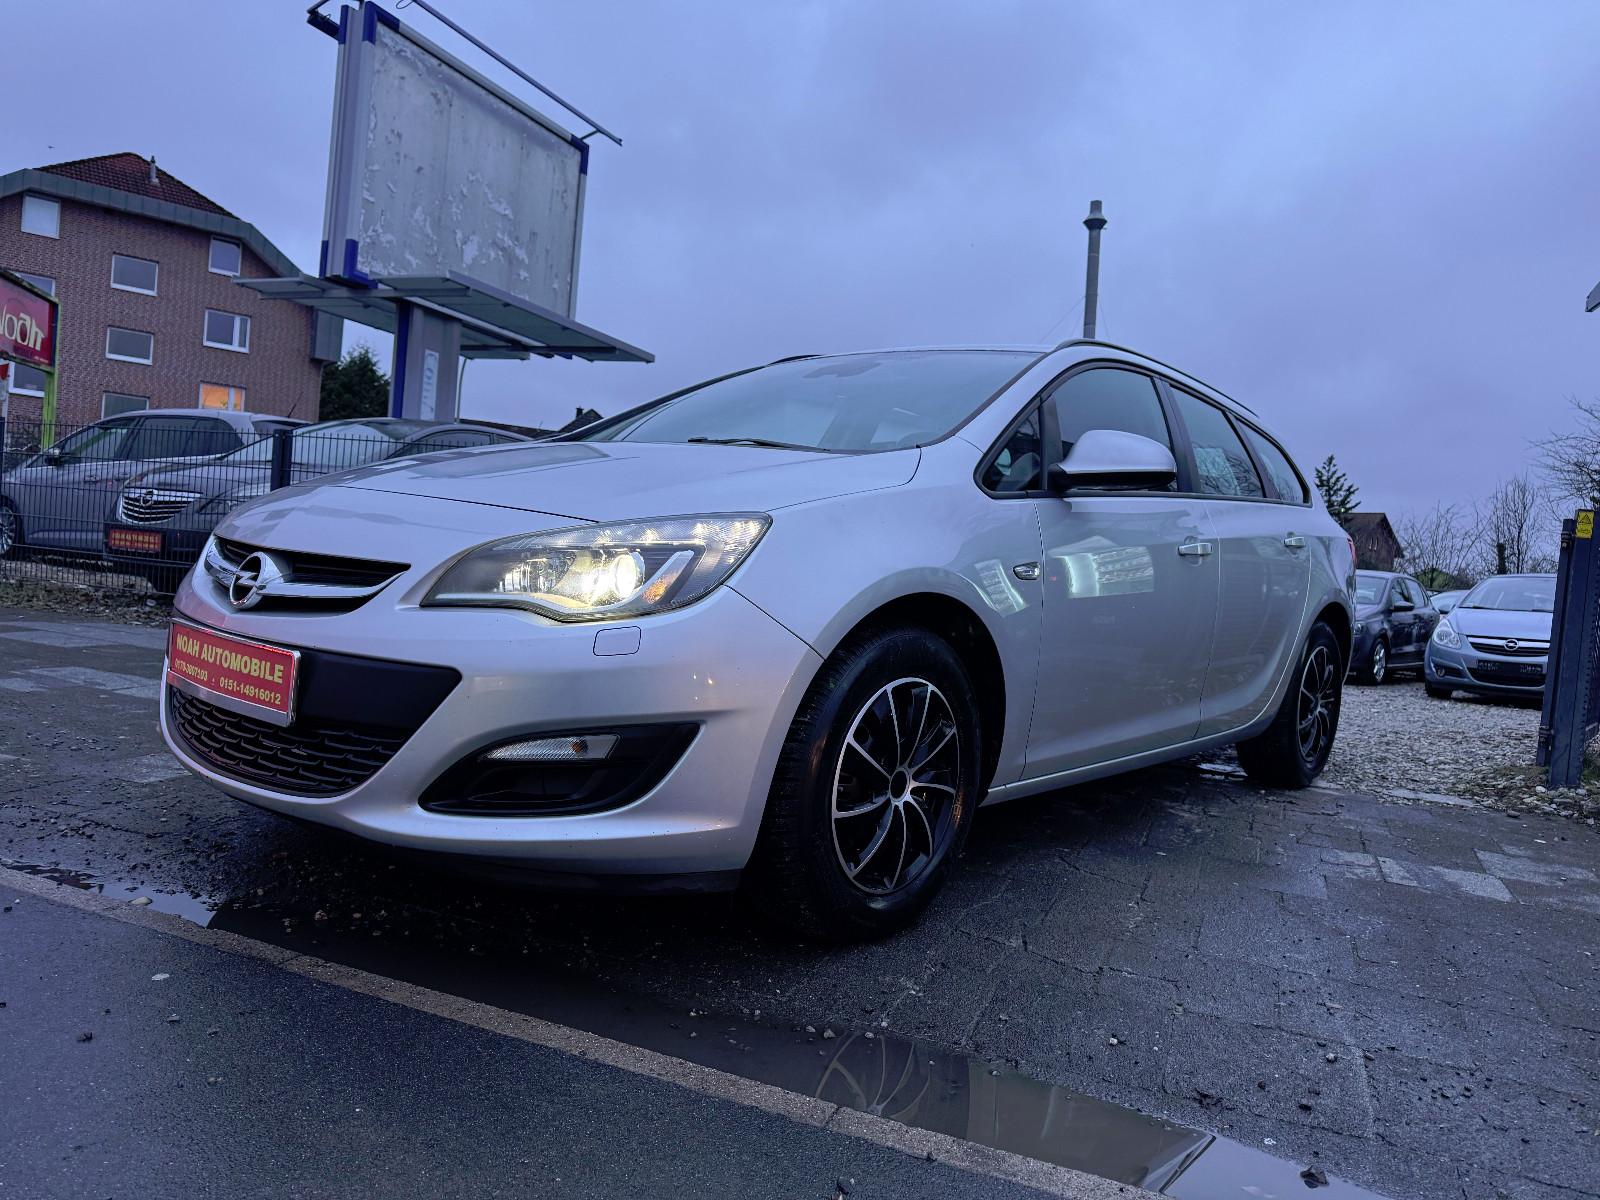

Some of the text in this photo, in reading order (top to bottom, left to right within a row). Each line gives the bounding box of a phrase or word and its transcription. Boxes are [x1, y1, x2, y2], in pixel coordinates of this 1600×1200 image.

[176, 633, 284, 684] NOAH AUTOMOBILE
[219, 676, 281, 705] 0151-14916012
